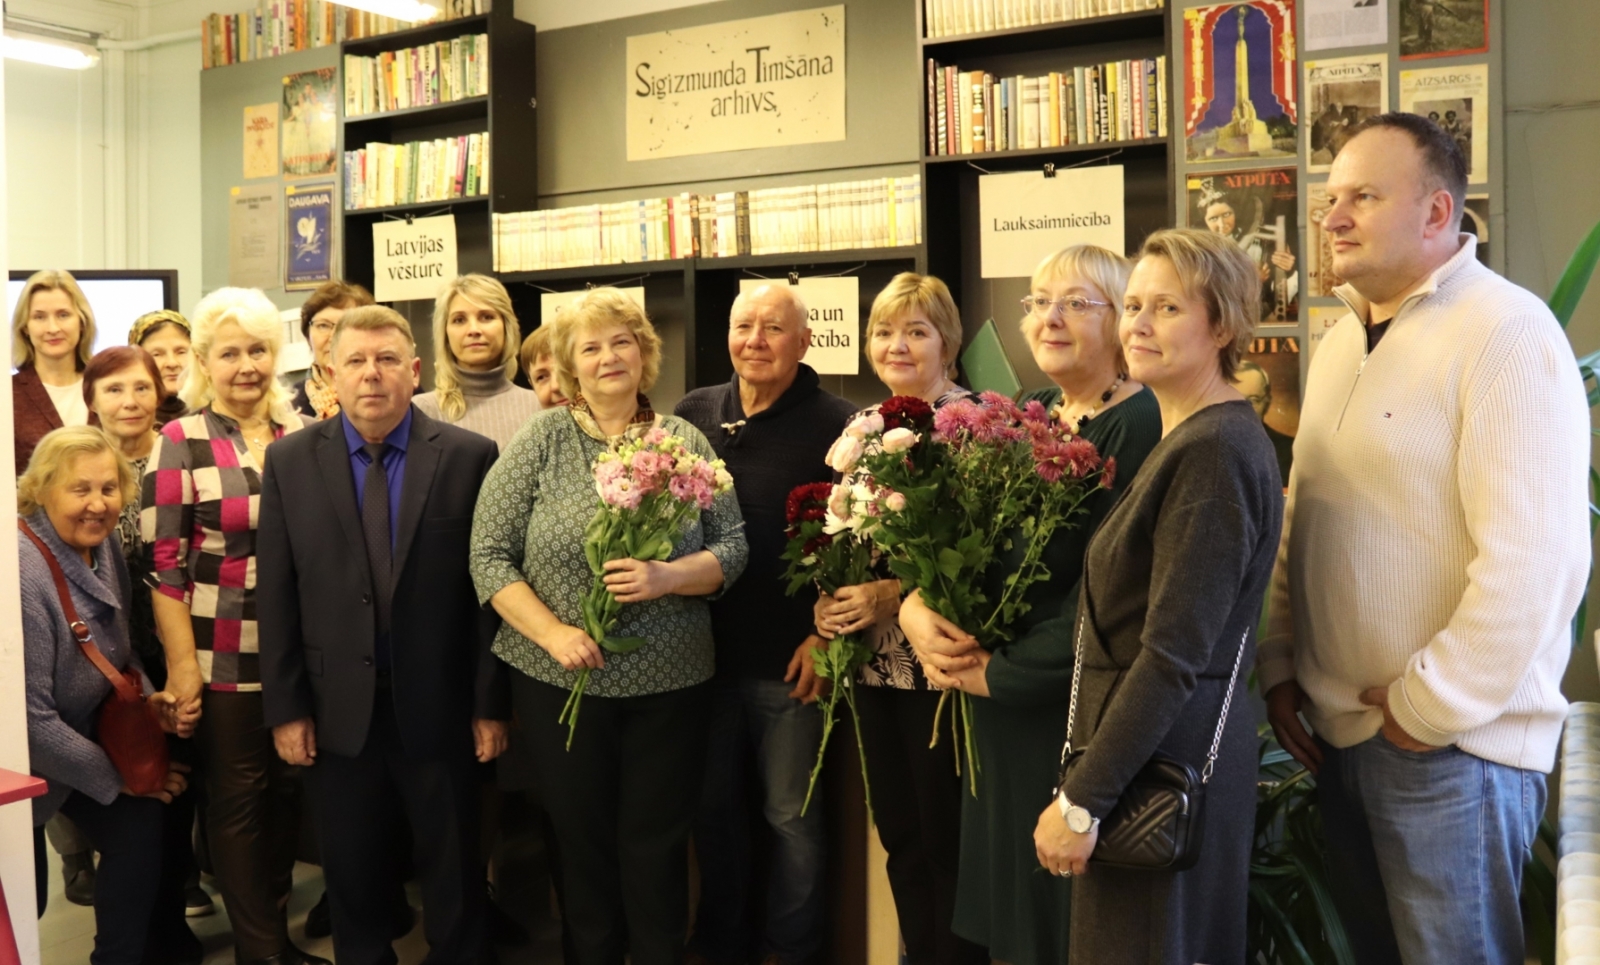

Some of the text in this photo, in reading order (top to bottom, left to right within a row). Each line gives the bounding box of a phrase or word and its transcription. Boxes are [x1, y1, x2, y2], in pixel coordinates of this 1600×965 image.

[635, 46, 834, 100] Sigizmunda Timšāna
[1415, 74, 1471, 87] AIZSARGS
[711, 90, 776, 117] arhīvs
[289, 194, 330, 208] DAUGAVA
[993, 211, 1111, 232] Lauksaimniecība
[386, 235, 444, 259] Latvijas
[388, 261, 443, 280] vēsture
[823, 308, 843, 321] un
